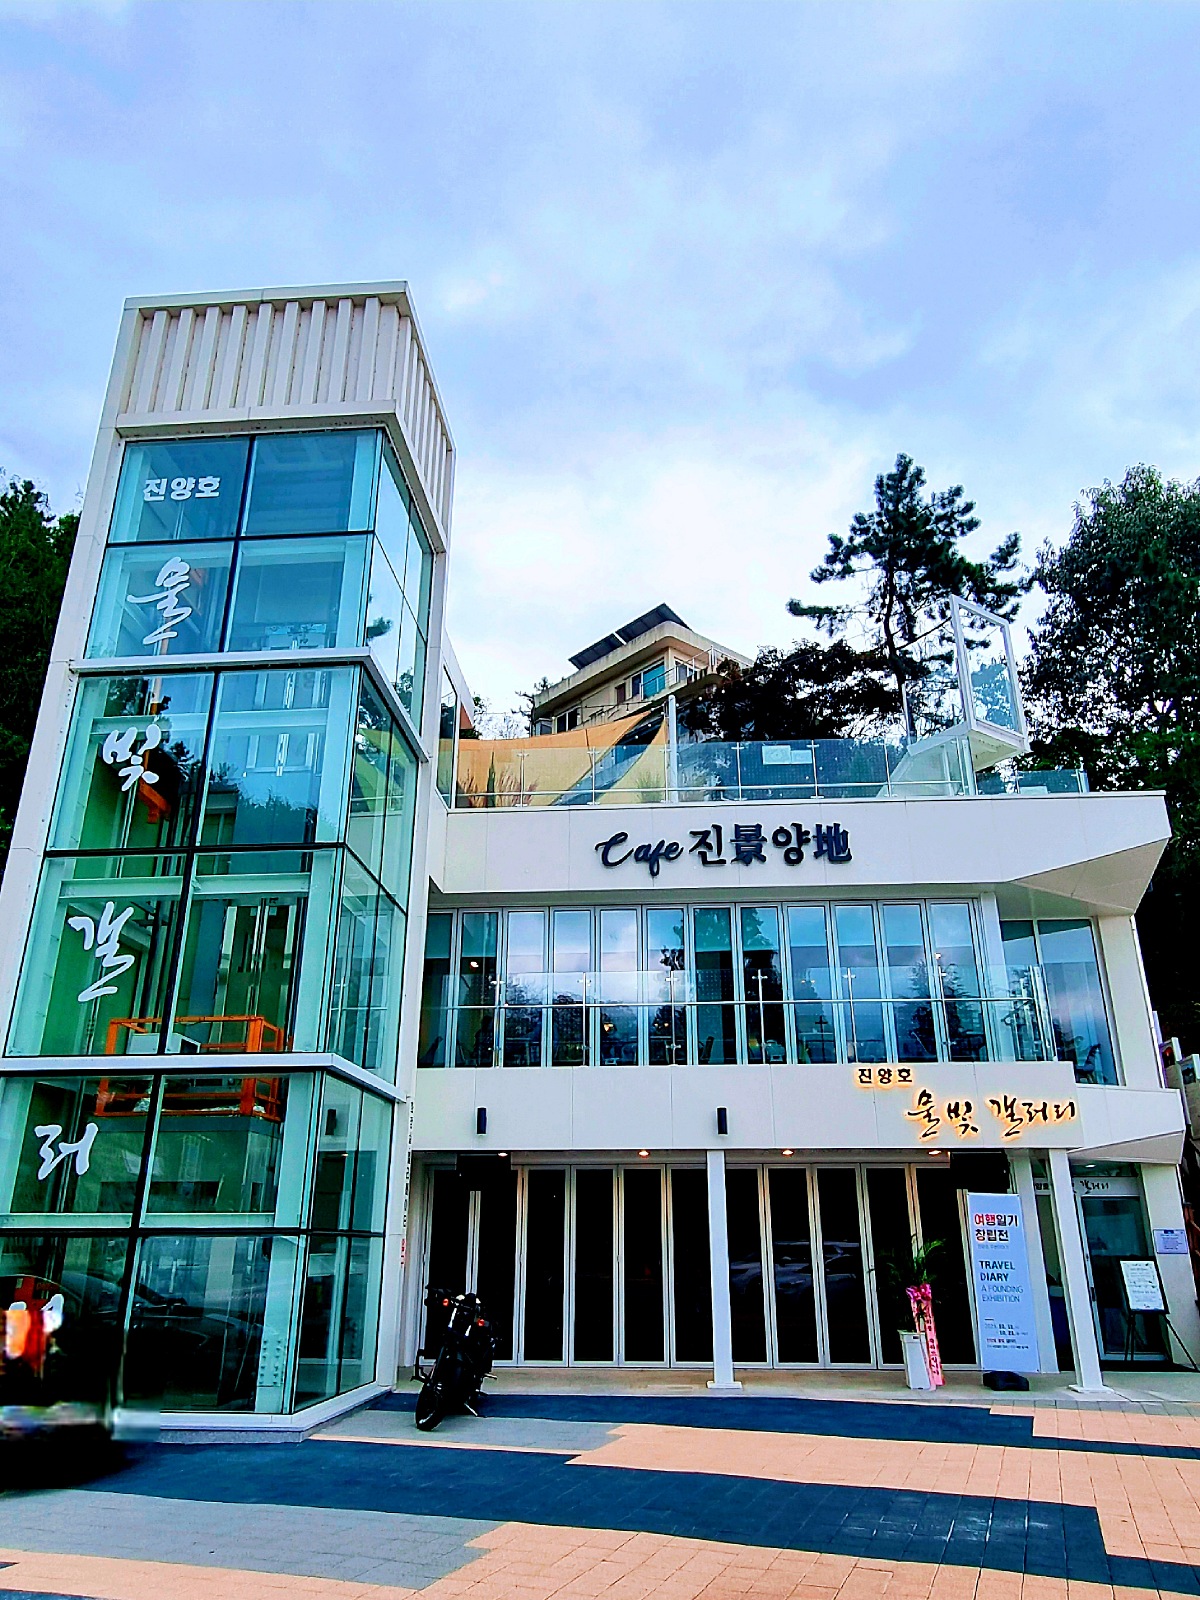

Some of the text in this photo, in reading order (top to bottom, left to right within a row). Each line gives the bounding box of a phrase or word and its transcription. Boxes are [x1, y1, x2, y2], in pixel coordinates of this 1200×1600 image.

[143, 476, 221, 502] 진양호
[595, 831, 684, 877] Cafe
[858, 1067, 913, 1085] 진양호
[907, 1089, 1075, 1138] 물빛 갤러리
[974, 1213, 1018, 1227] 여행일기
[975, 1228, 1010, 1242] 창립전
[979, 1260, 1016, 1270] TRAVEL
[980, 1272, 1009, 1282] DIARY
[981, 1284, 987, 1292] A
